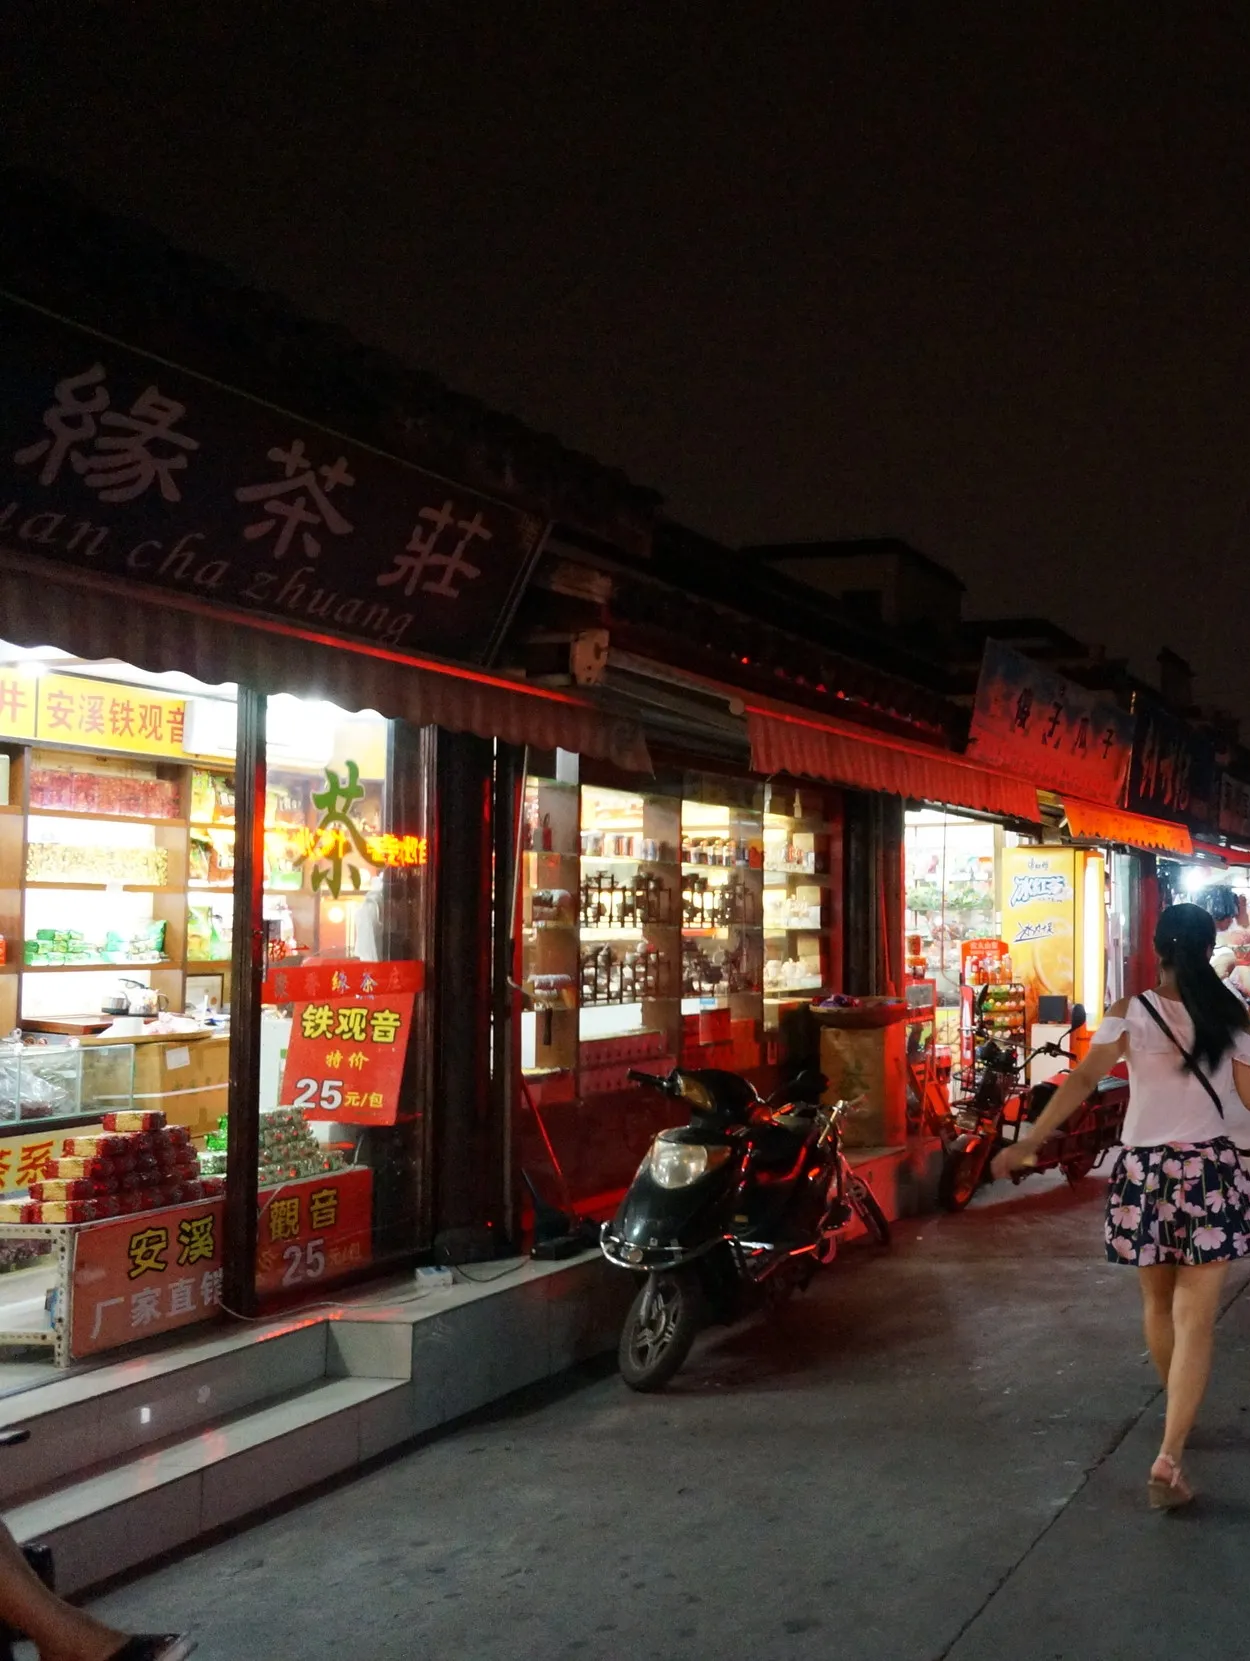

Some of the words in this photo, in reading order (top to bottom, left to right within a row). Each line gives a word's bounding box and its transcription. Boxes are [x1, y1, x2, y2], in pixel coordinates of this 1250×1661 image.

[126, 532, 231, 589] cha
[238, 565, 417, 646] zhuang
[47, 689, 184, 744] 安溪铁观音
[302, 1004, 401, 1043] 铁观音
[325, 1050, 370, 1071] 特价
[127, 1214, 216, 1280] 安溪
[268, 1187, 339, 1242] 觀音
